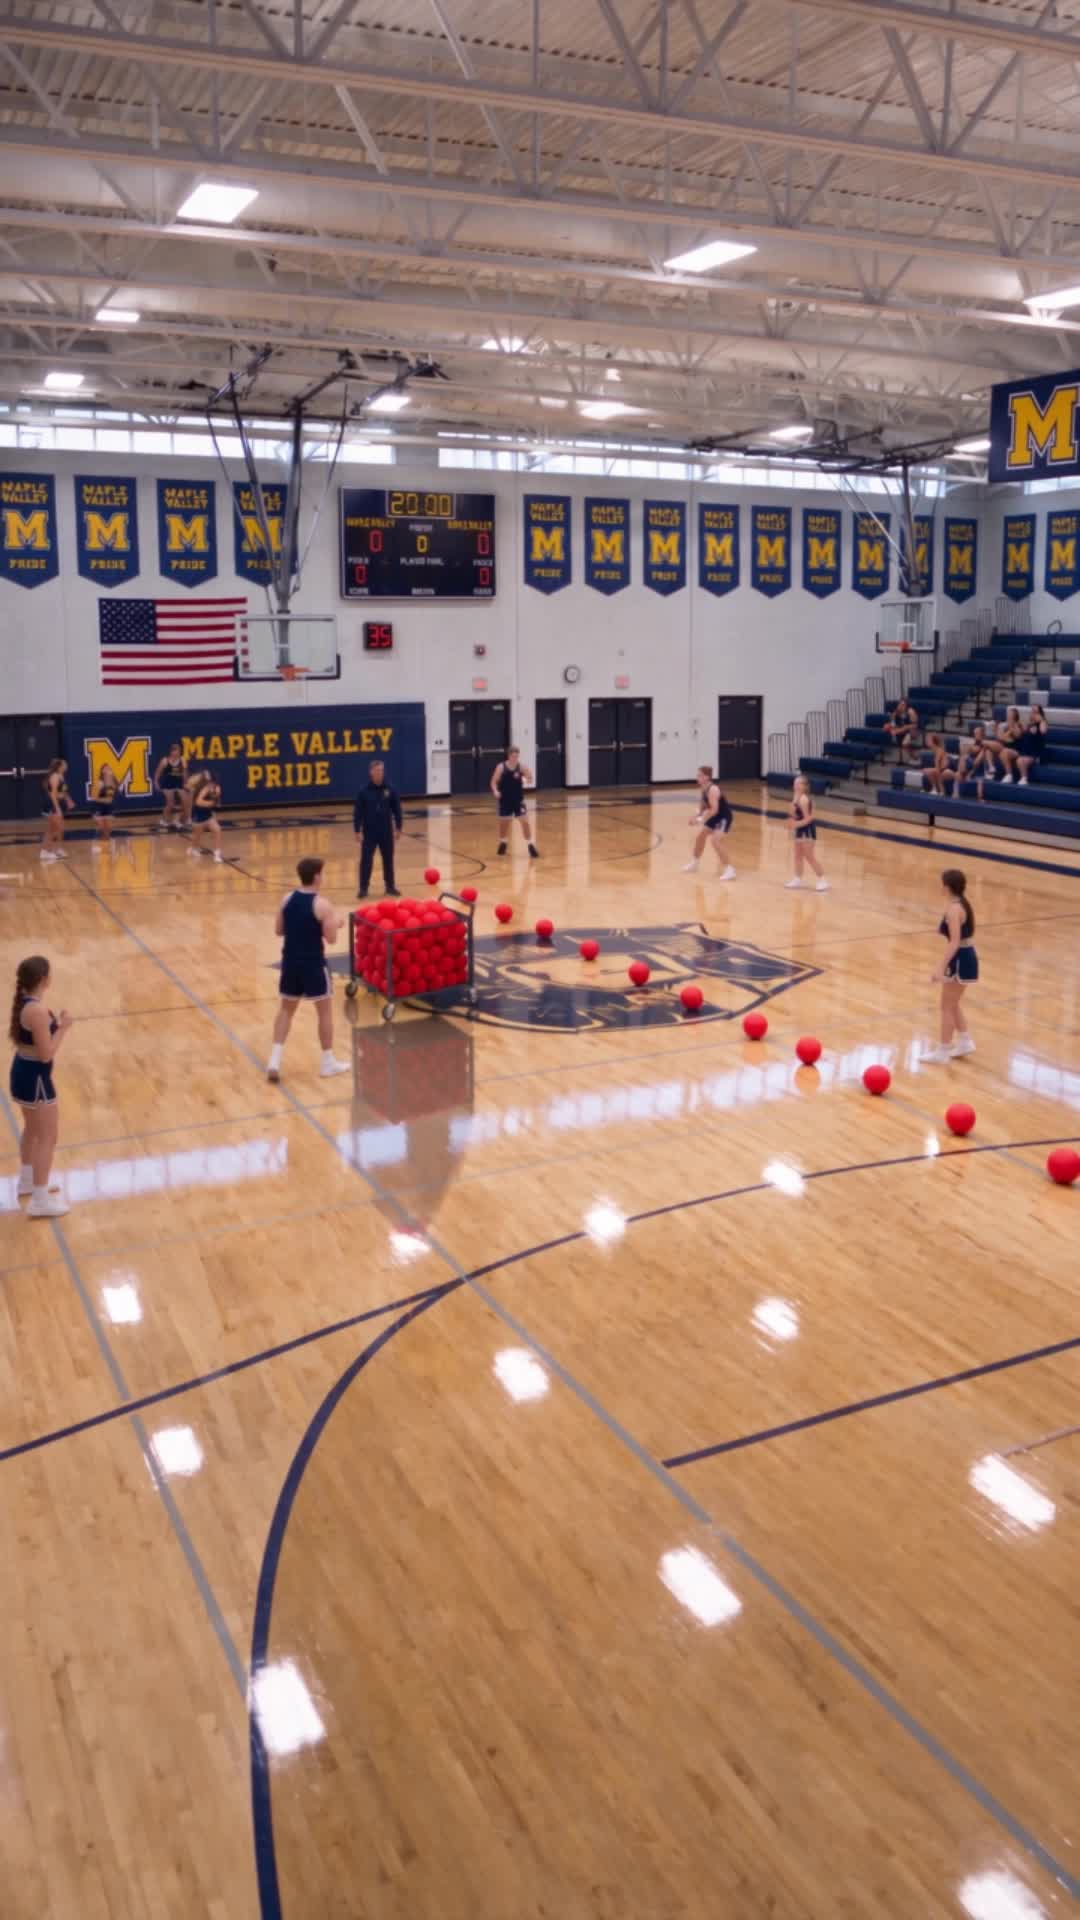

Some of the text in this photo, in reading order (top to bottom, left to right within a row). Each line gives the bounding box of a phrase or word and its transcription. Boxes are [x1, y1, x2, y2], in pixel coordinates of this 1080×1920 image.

[1006, 382, 1080, 470] M
[3, 508, 51, 550] M
[84, 511, 130, 552] M
[166, 514, 209, 552] M
[531, 527, 564, 561] M
[591, 529, 624, 563] M
[649, 531, 680, 565] M
[704, 534, 734, 567] M
[757, 536, 786, 568] M
[808, 538, 836, 569] M
[857, 540, 885, 572] M
[949, 545, 973, 576] M
[1007, 543, 1030, 574] M
[1050, 539, 1077, 572] M
[368, 625, 392, 648] 35
[180, 728, 393, 761] MAPLE VALLEY
[84, 736, 153, 802] M
[247, 760, 331, 789] PRIDE
